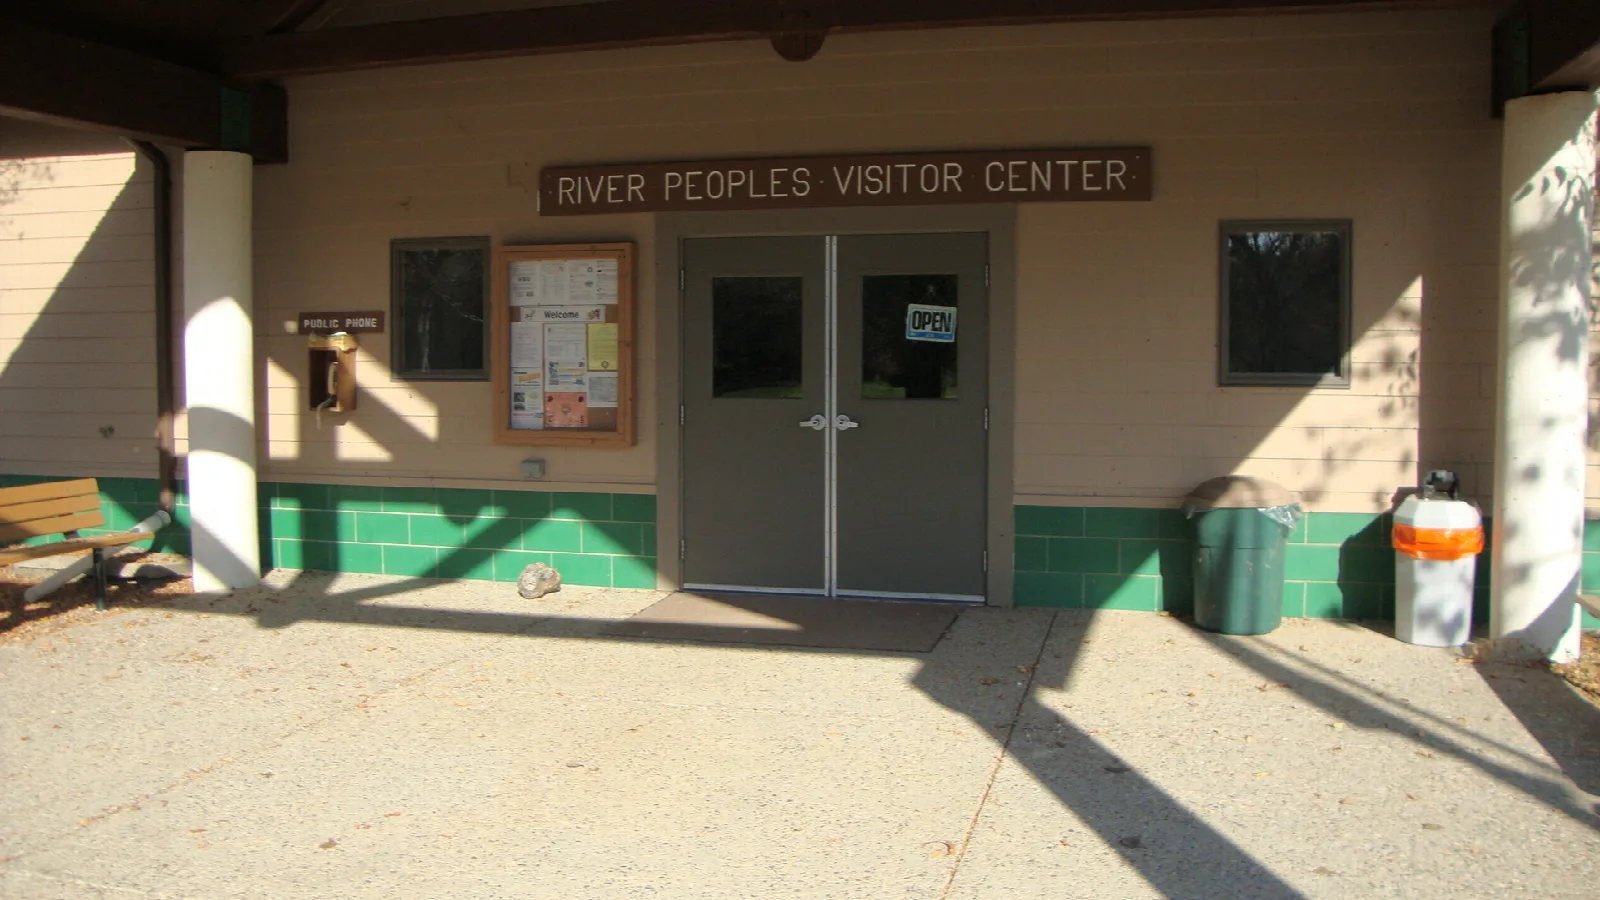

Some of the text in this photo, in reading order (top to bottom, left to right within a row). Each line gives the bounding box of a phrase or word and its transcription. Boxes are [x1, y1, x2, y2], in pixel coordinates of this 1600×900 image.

[557, 159, 1128, 206] RIVER PEOPLES VISITOR CENTER
[303, 317, 378, 329] PUBLIC PHONE
[543, 310, 580, 319] Welcome
[911, 310, 952, 333] OPEN
